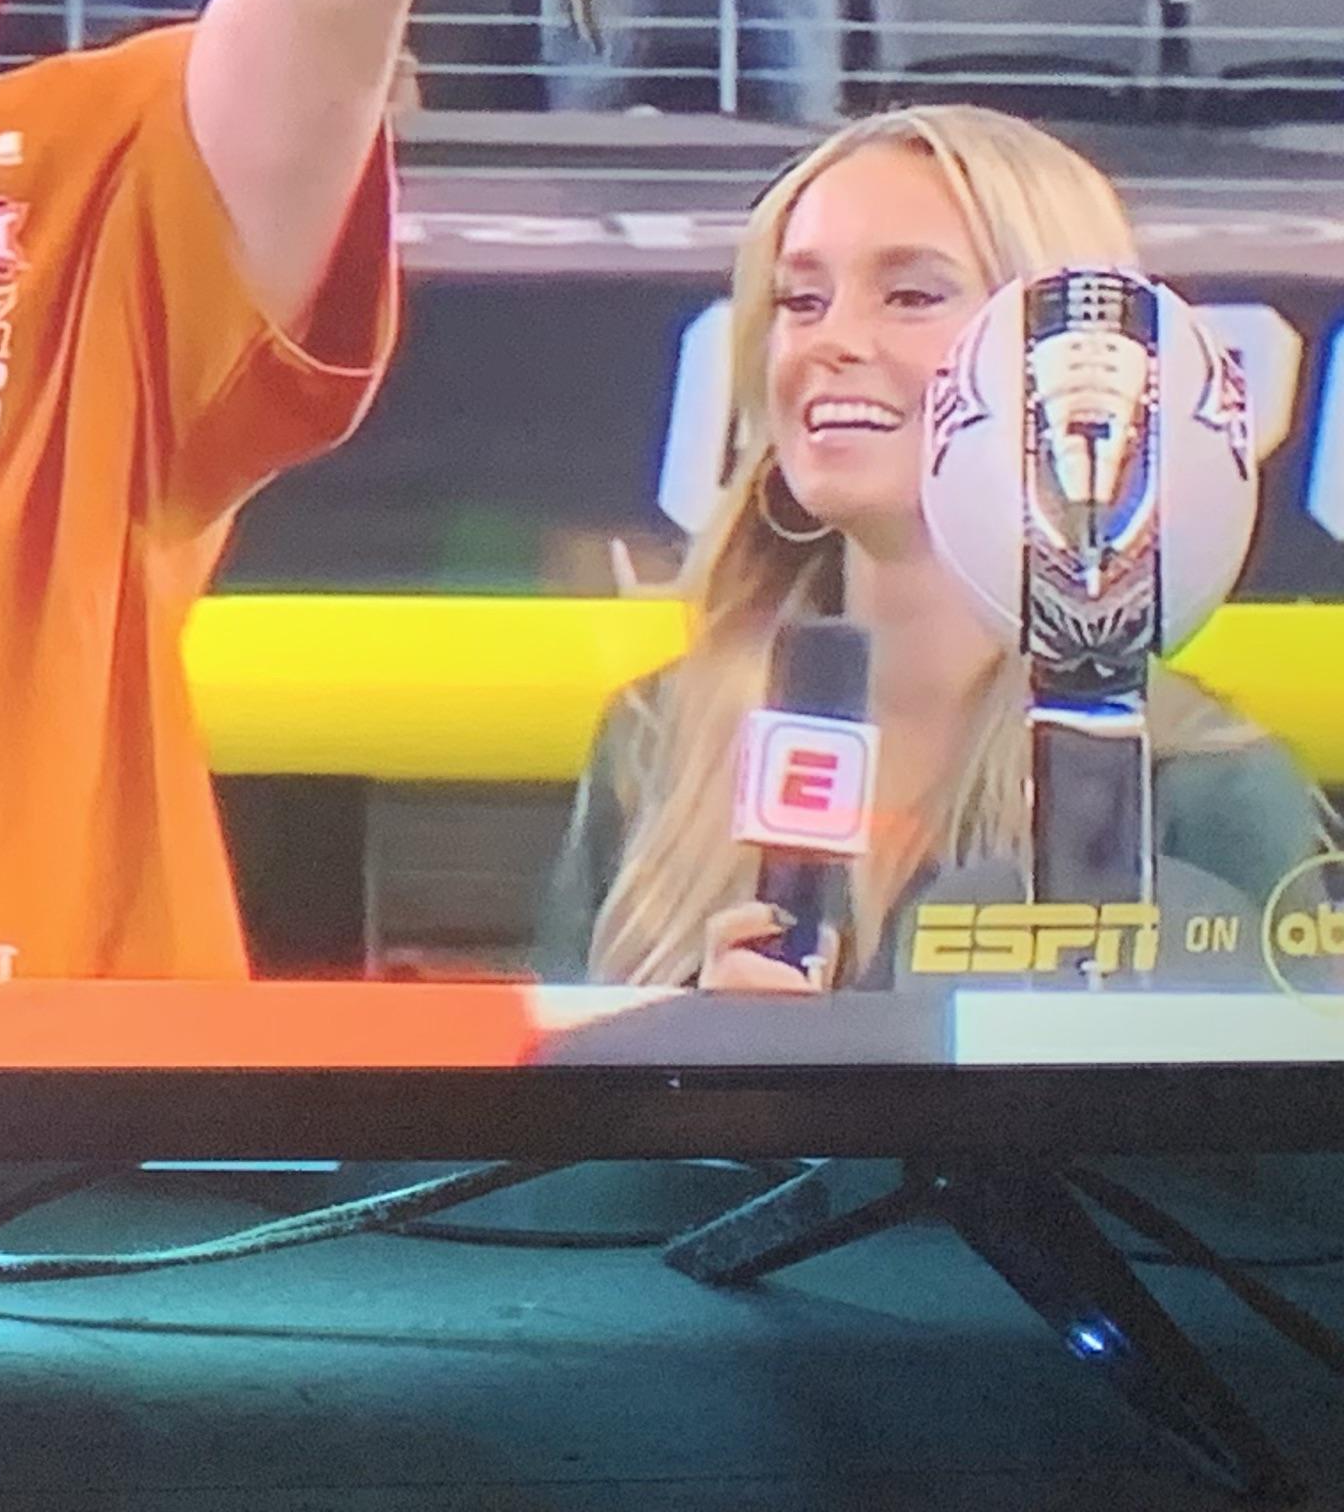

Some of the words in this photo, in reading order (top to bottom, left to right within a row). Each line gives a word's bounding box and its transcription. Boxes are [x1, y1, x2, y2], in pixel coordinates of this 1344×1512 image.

[780, 749, 839, 811] E
[912, 902, 1161, 974] ESPN
[1184, 915, 1240, 952] ON
[1277, 903, 1343, 955] ab
